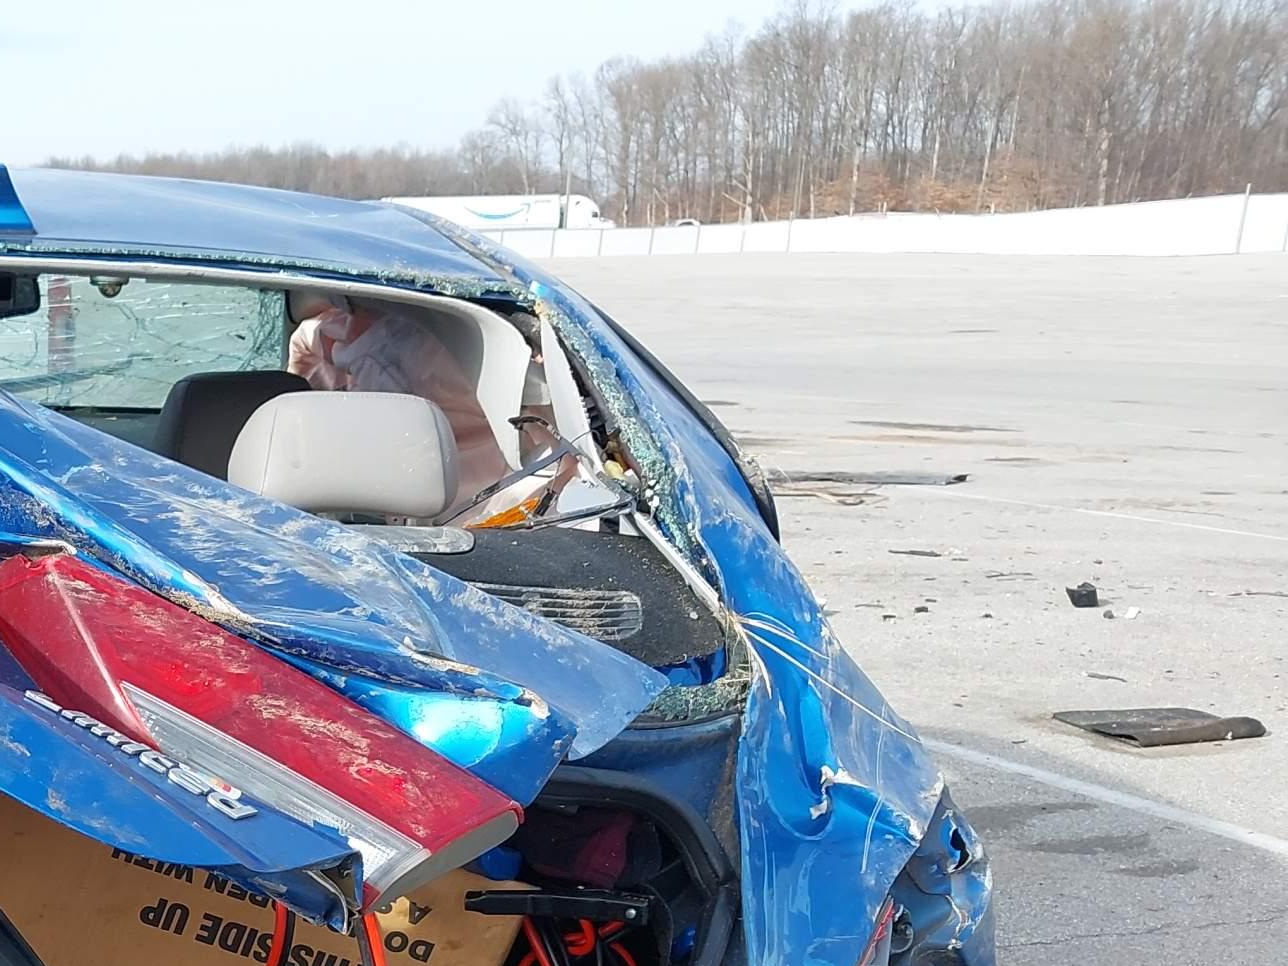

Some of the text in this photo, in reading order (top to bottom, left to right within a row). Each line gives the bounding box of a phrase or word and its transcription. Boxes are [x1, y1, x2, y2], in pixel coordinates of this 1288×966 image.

[203, 870, 280, 912] PEN
[139, 897, 191, 936] UP
[194, 912, 274, 964] SIDE
[384, 931, 436, 964] DO
